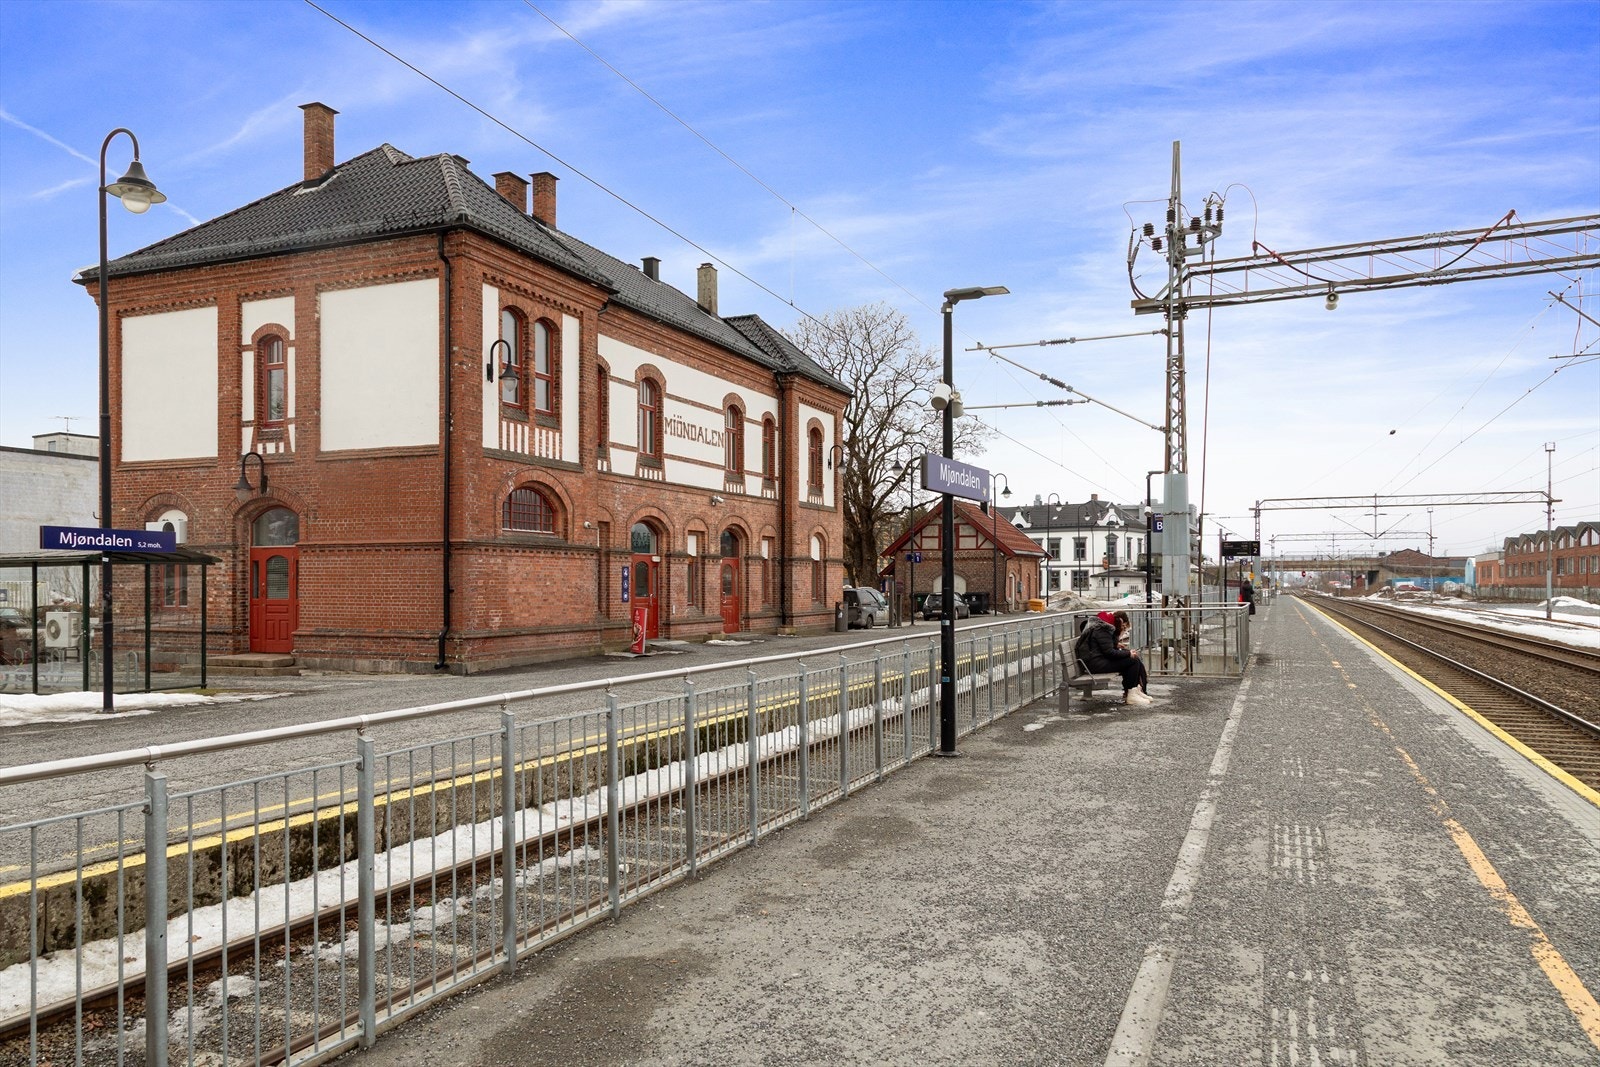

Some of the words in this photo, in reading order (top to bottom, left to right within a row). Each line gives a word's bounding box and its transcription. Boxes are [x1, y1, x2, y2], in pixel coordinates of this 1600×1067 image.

[940, 463, 980, 490] Mjøndalen
[1156, 521, 1163, 530] B
[59, 532, 132, 548] Mjøndalen
[137, 541, 147, 549] 5,2
